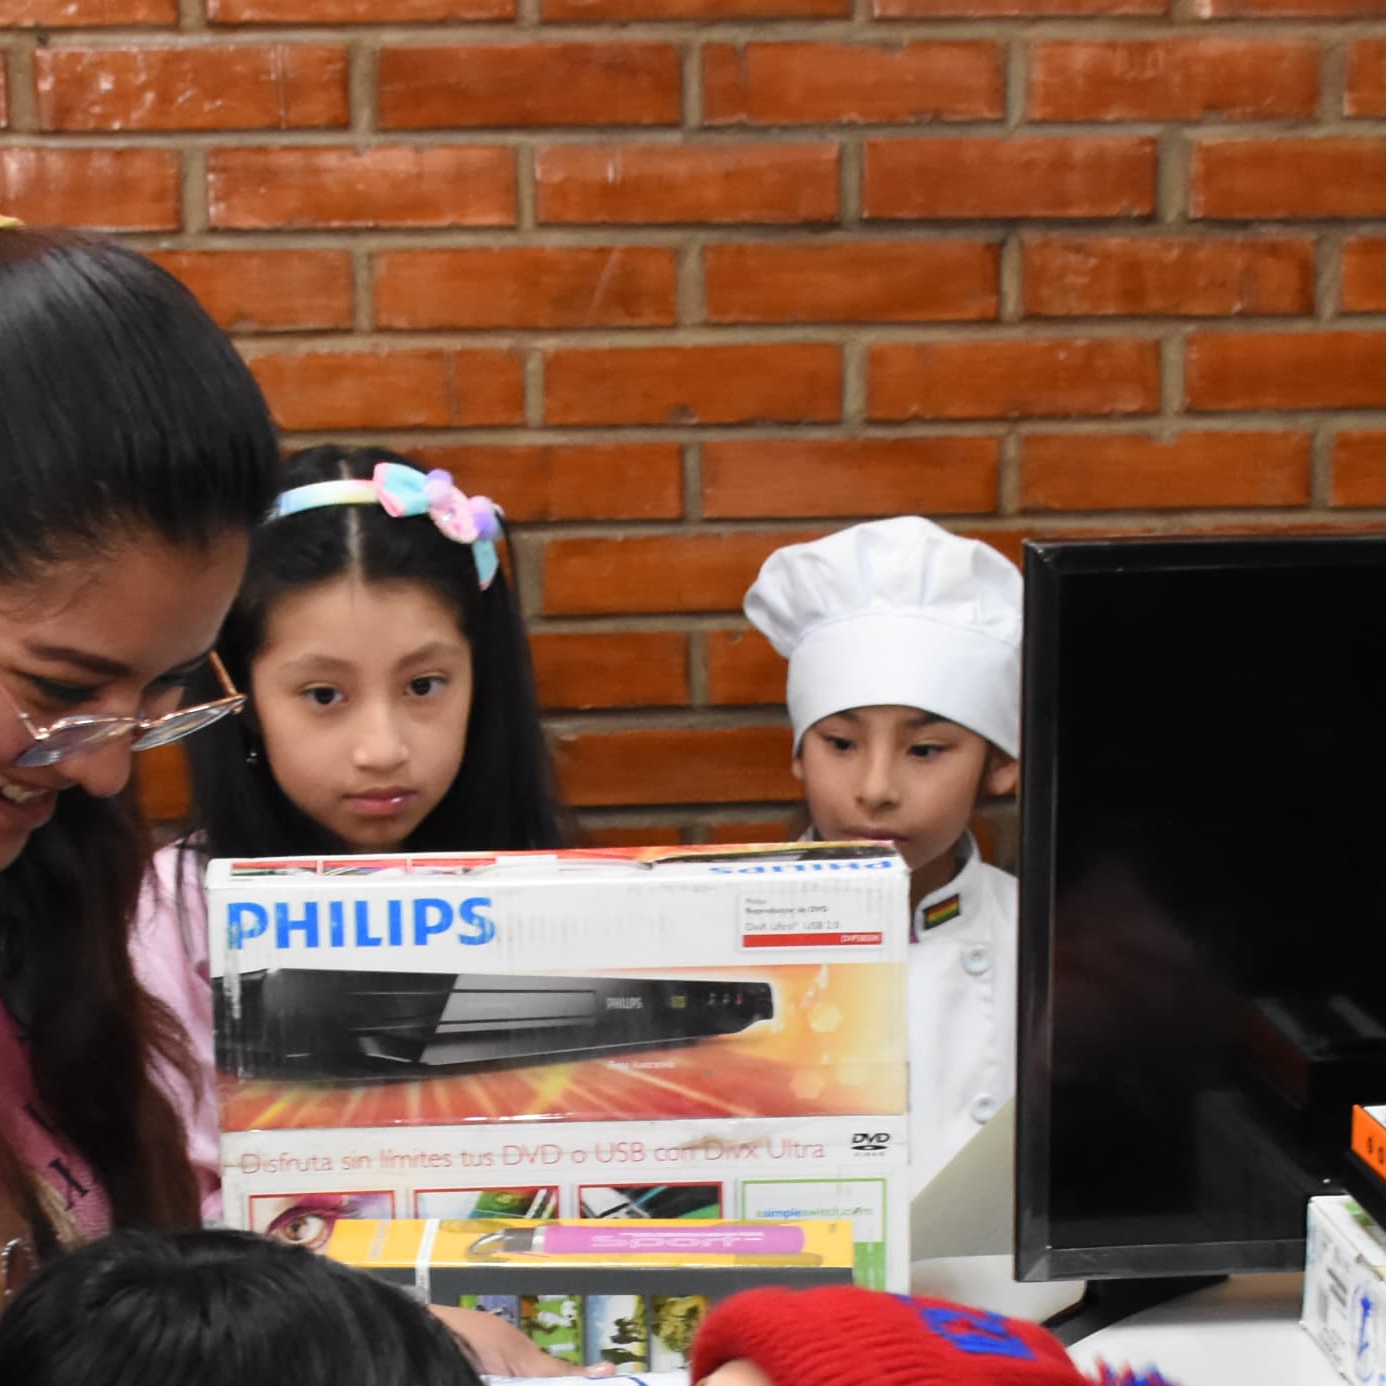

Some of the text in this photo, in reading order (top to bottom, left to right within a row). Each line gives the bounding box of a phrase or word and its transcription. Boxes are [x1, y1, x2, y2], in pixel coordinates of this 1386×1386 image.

[225, 896, 497, 950] PHILIPS
[239, 1151, 333, 1174] Disfruta
[341, 1150, 370, 1170] sin
[460, 1149, 495, 1167] tus
[502, 1143, 561, 1167] DVD
[571, 1149, 588, 1164] o
[594, 1141, 646, 1163] USB
[652, 1143, 692, 1162] con
[767, 1136, 826, 1160] Ultra
[851, 1132, 891, 1144] DVD
